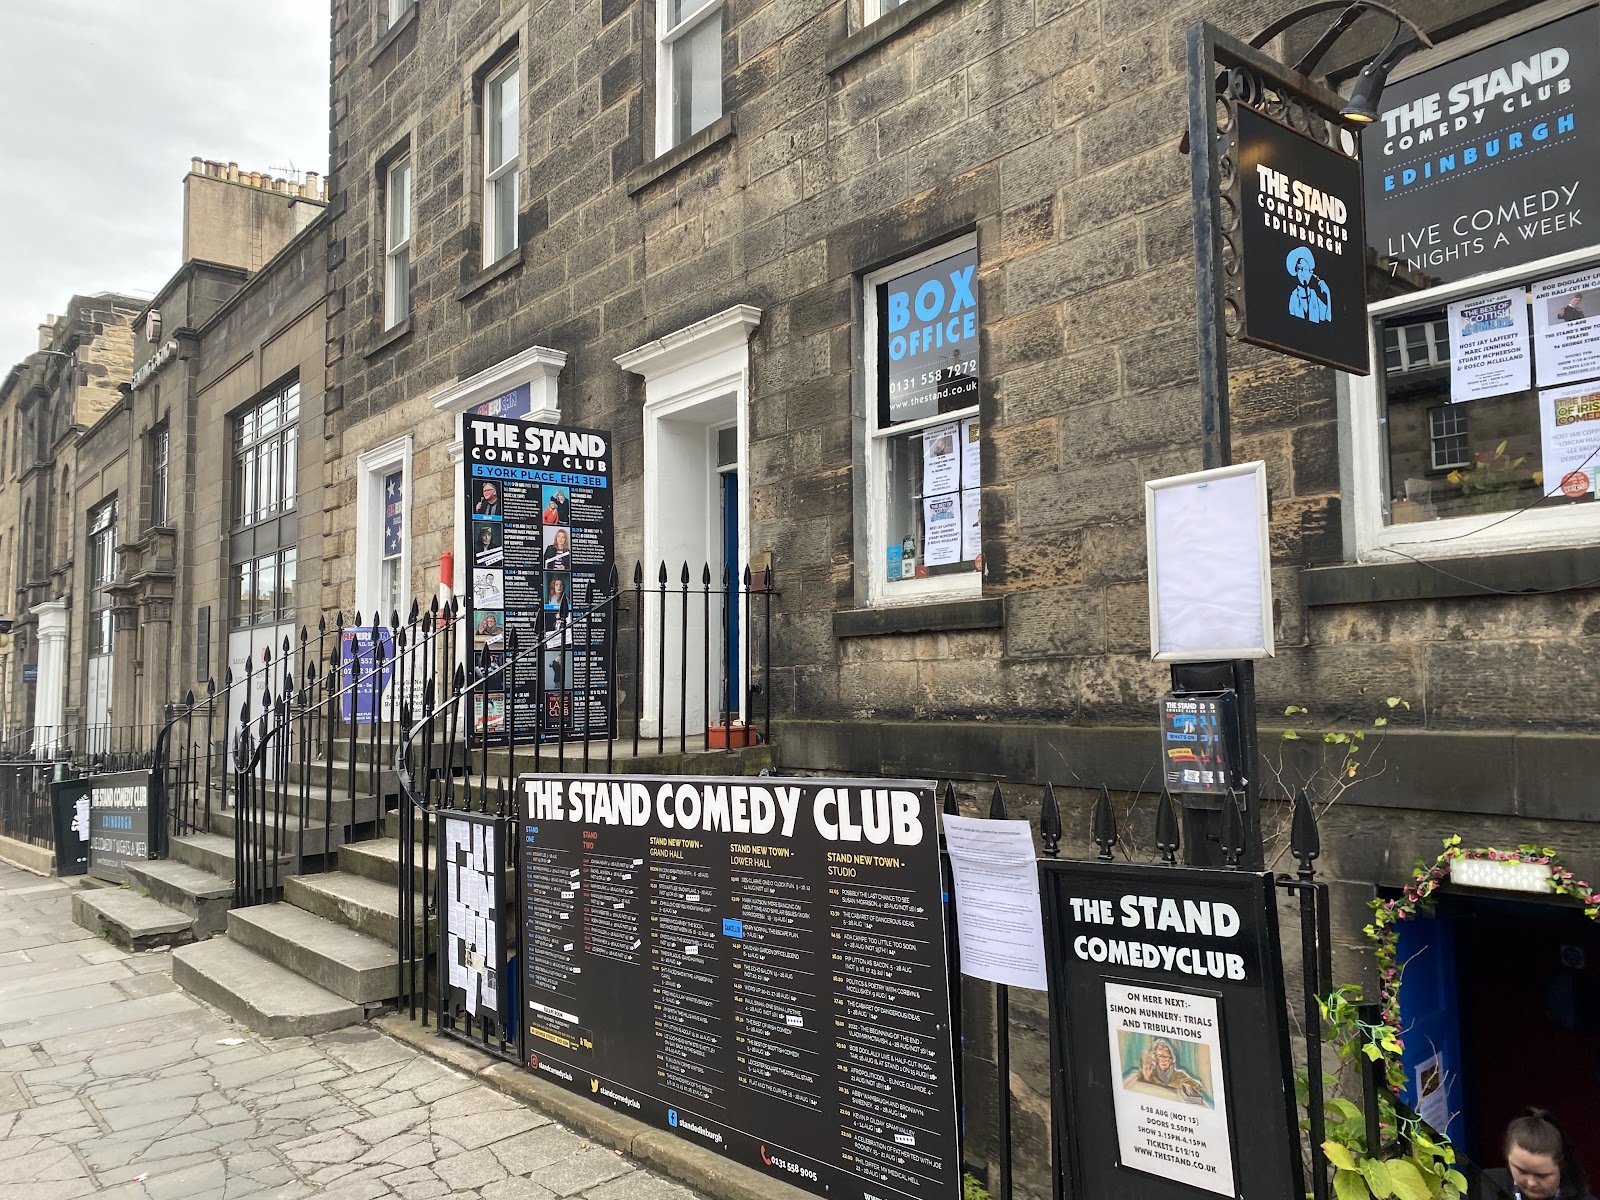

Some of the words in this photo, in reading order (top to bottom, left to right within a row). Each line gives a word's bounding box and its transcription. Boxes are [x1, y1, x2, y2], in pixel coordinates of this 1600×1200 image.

[1381, 92, 1442, 138] THE
[1448, 47, 1570, 107] STAND
[1384, 108, 1486, 156] COMEDY
[1502, 79, 1572, 114] CLUB
[1384, 113, 1575, 192] EDINBURGH
[1256, 164, 1290, 202] THE
[1293, 178, 1347, 225] STAND
[1258, 194, 1312, 227] COMEDY
[1318, 216, 1348, 241] CLUB
[1388, 224, 1441, 257] LIVE
[1452, 181, 1580, 237] COMEDY
[1264, 213, 1342, 256] EDINBURGH
[1388, 262, 1398, 278] 7
[1407, 239, 1484, 273] NIGHTS
[1493, 232, 1510, 250] A
[1517, 209, 1582, 242] WEEK
[888, 265, 976, 334] BOX
[1464, 309, 1478, 317] THE
[1480, 304, 1497, 314] BEST
[889, 312, 976, 361] OFFICE
[1460, 342, 1476, 350] HOST
[1489, 332, 1518, 343] LAFFERTY
[1483, 341, 1514, 352] JENNINGS
[1458, 356, 1482, 364] STUART
[1482, 347, 1521, 360] MCPHERSON
[890, 376, 915, 394] 0131
[921, 370, 942, 386] 558
[948, 360, 976, 378] 7272
[890, 381, 977, 410] www.thestand.co.uk
[1558, 406, 1574, 416] OF
[470, 420, 520, 449] THE
[524, 426, 606, 458] STAND
[472, 447, 550, 466] COMEDY
[562, 457, 606, 472] CLUB
[477, 466, 483, 474] 5
[487, 467, 518, 478] YORK
[521, 470, 558, 484] PLACE,
[560, 474, 580, 486] EH1
[583, 476, 602, 486] 3EB
[100, 788, 114, 806] STAND
[114, 786, 134, 807] COMEDY
[524, 780, 564, 820] THE
[568, 781, 652, 826] STAND
[656, 783, 801, 838] COMEDY
[813, 787, 924, 846] CLUB
[526, 826, 538, 834] STAND
[582, 831, 598, 839] STAND
[583, 842, 594, 850] TWO
[650, 837, 668, 846] STAND
[668, 838, 682, 848] NEW
[682, 840, 700, 849] TOWN
[650, 848, 668, 858] GRAND
[669, 850, 684, 860] HALL
[730, 843, 751, 854] STAND
[752, 845, 768, 856] NEW
[768, 846, 790, 858] TOWN
[730, 856, 754, 867] LOWER
[754, 858, 772, 868] HALL
[827, 852, 852, 864] STAND
[854, 854, 873, 866] NEW
[874, 856, 900, 868] TOWN
[828, 865, 856, 878] STUDIO
[1070, 897, 1114, 926] THE
[1120, 894, 1240, 938] STAND
[1074, 935, 1246, 981] COMEDYCLUB
[1127, 992, 1140, 1002] ON
[1142, 994, 1163, 1005] HERE
[1110, 1004, 1136, 1015] SIMON
[1139, 1008, 1182, 1023] MUNNERY:
[1184, 1014, 1212, 1027] TRIALS
[1122, 1018, 1140, 1029] AND
[1142, 1022, 1202, 1039] TRIBULATIONS
[538, 1061, 573, 1082] standcomedyclub
[600, 1086, 641, 1110] standcomedyclub
[1146, 1118, 1169, 1128] DOORS
[1170, 1123, 1194, 1134] 2.50PM
[1155, 1108, 1168, 1118] AUG
[1170, 1112, 1186, 1122] (NOT
[1188, 1116, 1199, 1126] 15)
[678, 1118, 723, 1144] standedinburgh
[1138, 1126, 1156, 1136] SHOW
[1158, 1130, 1207, 1148] 3.15PM-4.15PM
[1146, 1138, 1174, 1152] TICKETS
[770, 1154, 786, 1169] 0131
[787, 1160, 800, 1174] 558
[800, 1166, 818, 1182] 9005
[1134, 1146, 1216, 1174] WWW.THESTAND.CO.UK
